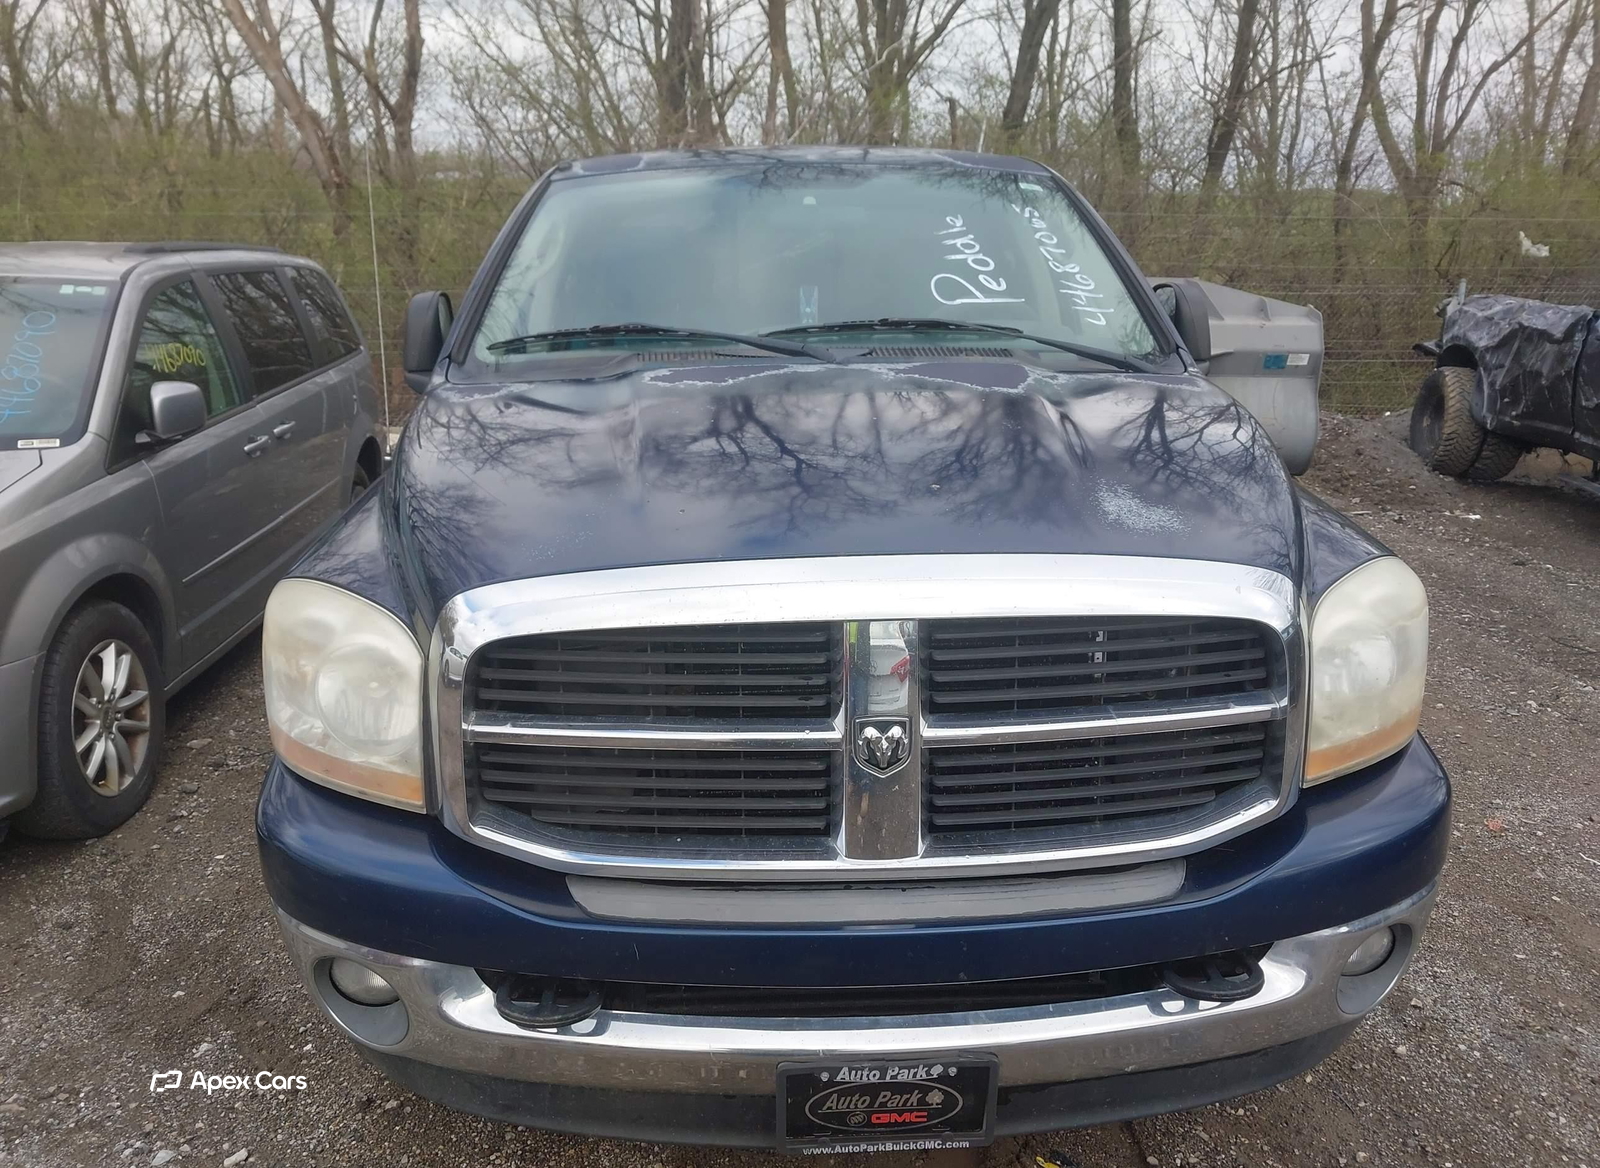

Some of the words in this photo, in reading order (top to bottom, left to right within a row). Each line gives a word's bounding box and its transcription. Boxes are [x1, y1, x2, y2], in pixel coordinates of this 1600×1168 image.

[930, 214, 1026, 305] Peddle
[836, 1067, 880, 1081] Auto
[885, 1064, 928, 1080] Park
[822, 1093, 869, 1111] Auto
[874, 1090, 923, 1108] Park
[871, 1111, 928, 1124] GMC
[802, 1140, 970, 1156] www.AutoParkBuickGMC.com
